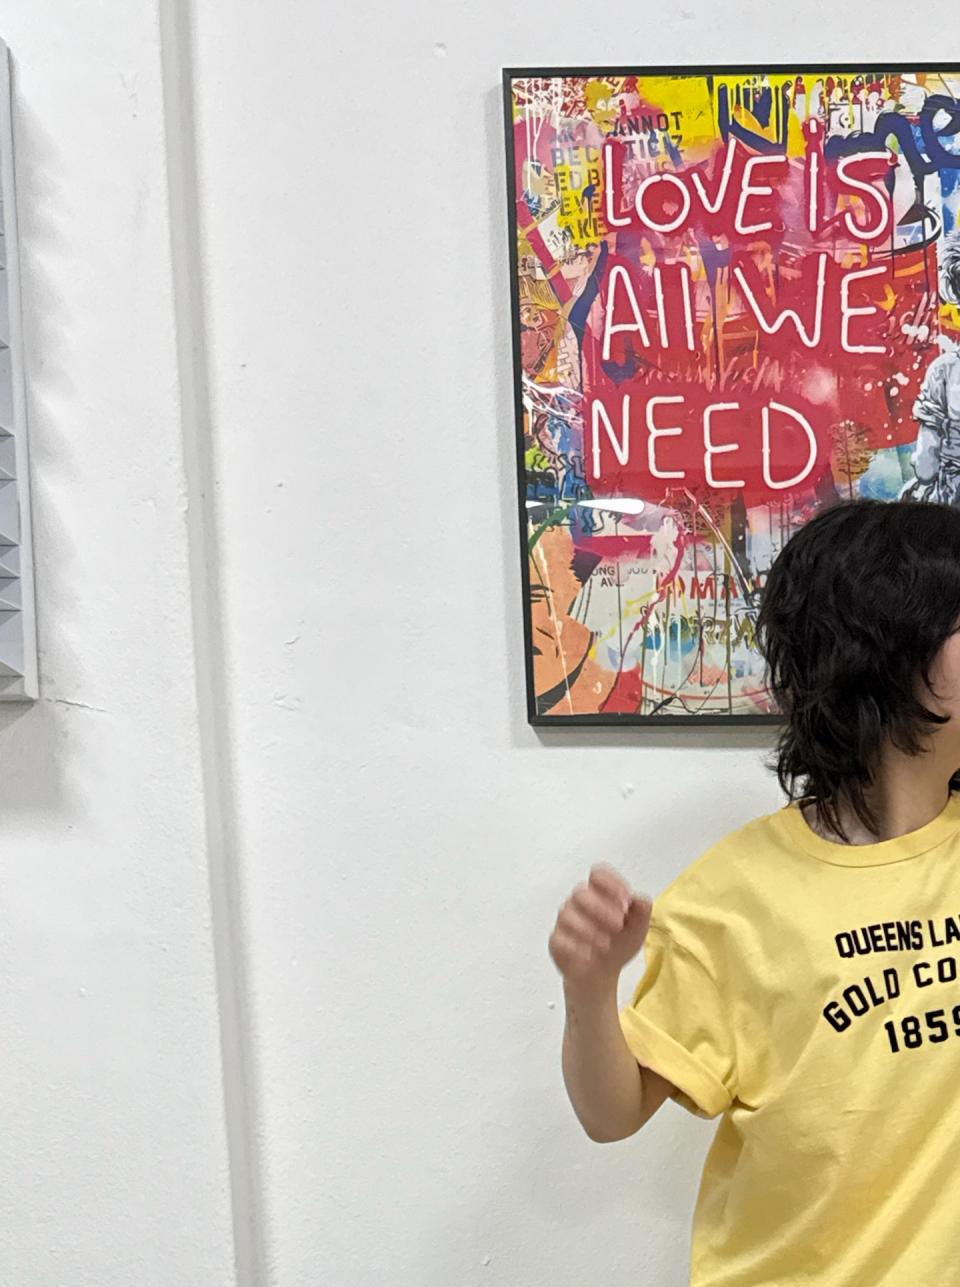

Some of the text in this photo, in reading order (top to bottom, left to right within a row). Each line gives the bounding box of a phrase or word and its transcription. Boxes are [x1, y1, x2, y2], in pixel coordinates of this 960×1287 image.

[604, 137, 787, 235] LOVE
[734, 253, 888, 354] WE
[591, 394, 818, 490] NEED
[834, 920, 924, 958] QUEENS
[822, 967, 900, 1033] GOLD
